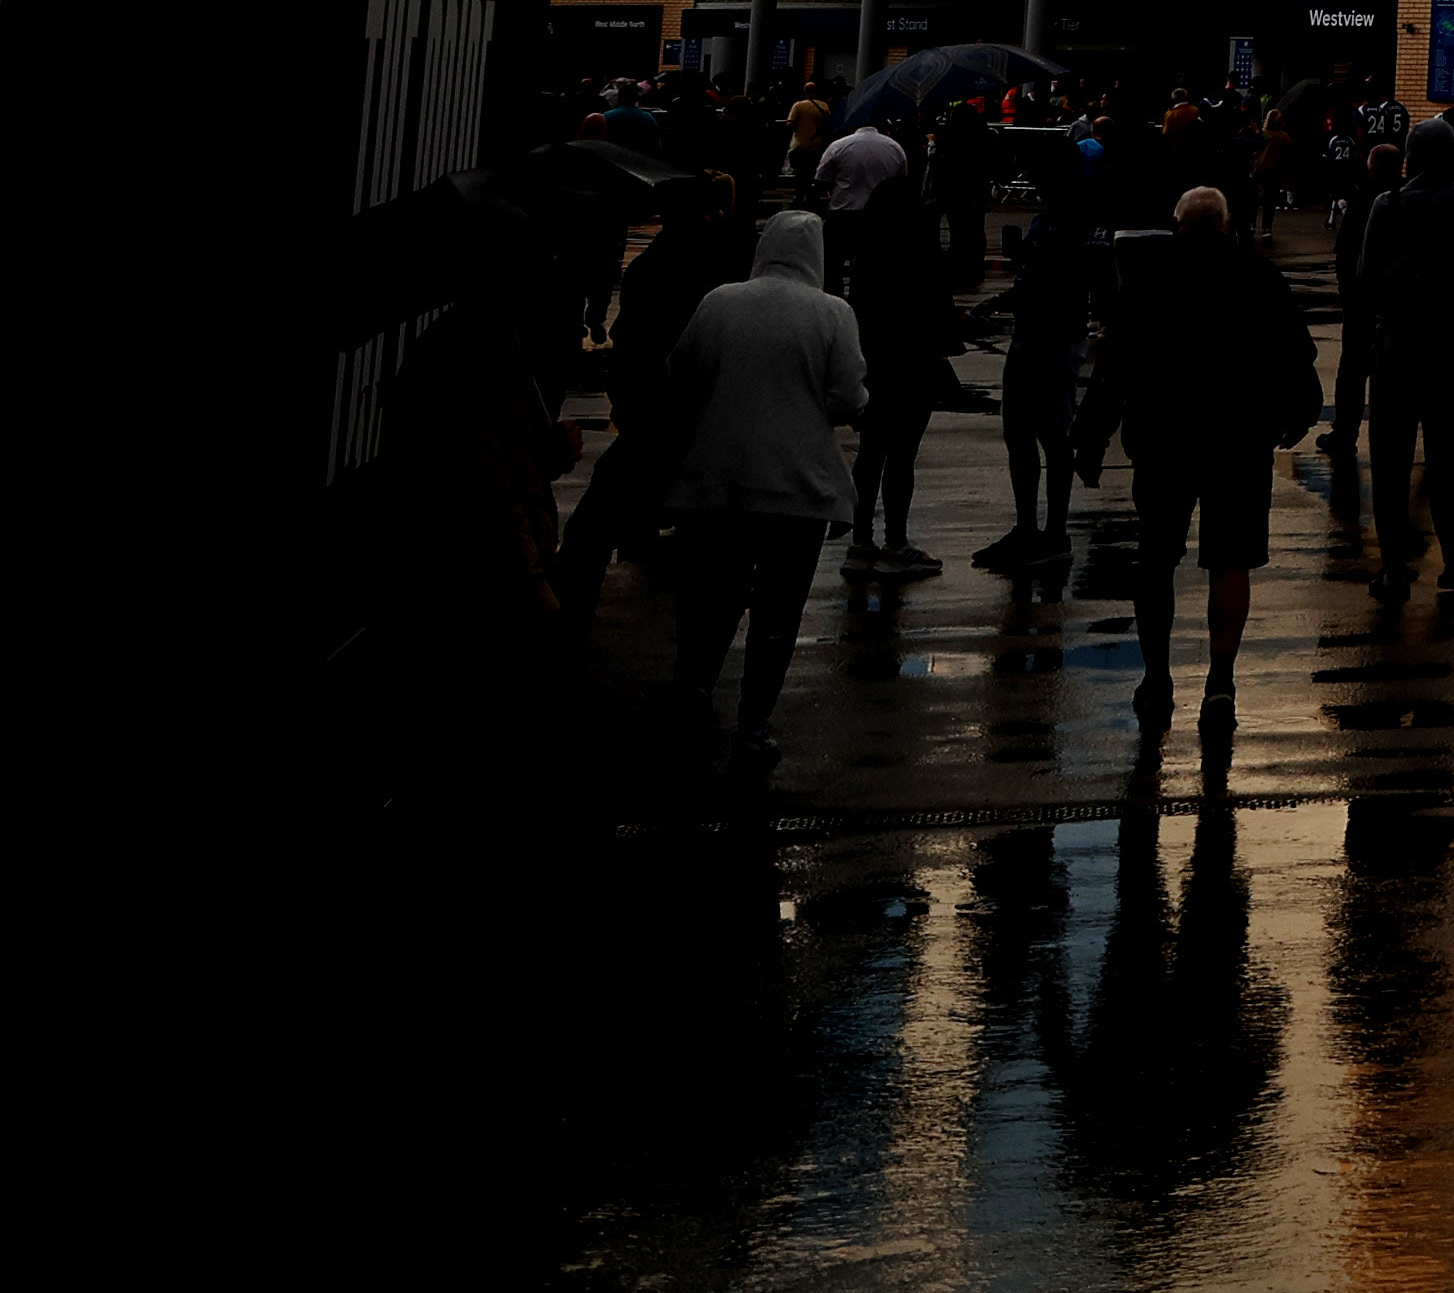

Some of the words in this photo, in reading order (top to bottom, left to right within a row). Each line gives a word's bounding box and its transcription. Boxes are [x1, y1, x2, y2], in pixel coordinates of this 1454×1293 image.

[1309, 9, 1375, 27] Westview
[1368, 115, 1385, 134] 24
[1335, 146, 1350, 161] 24
